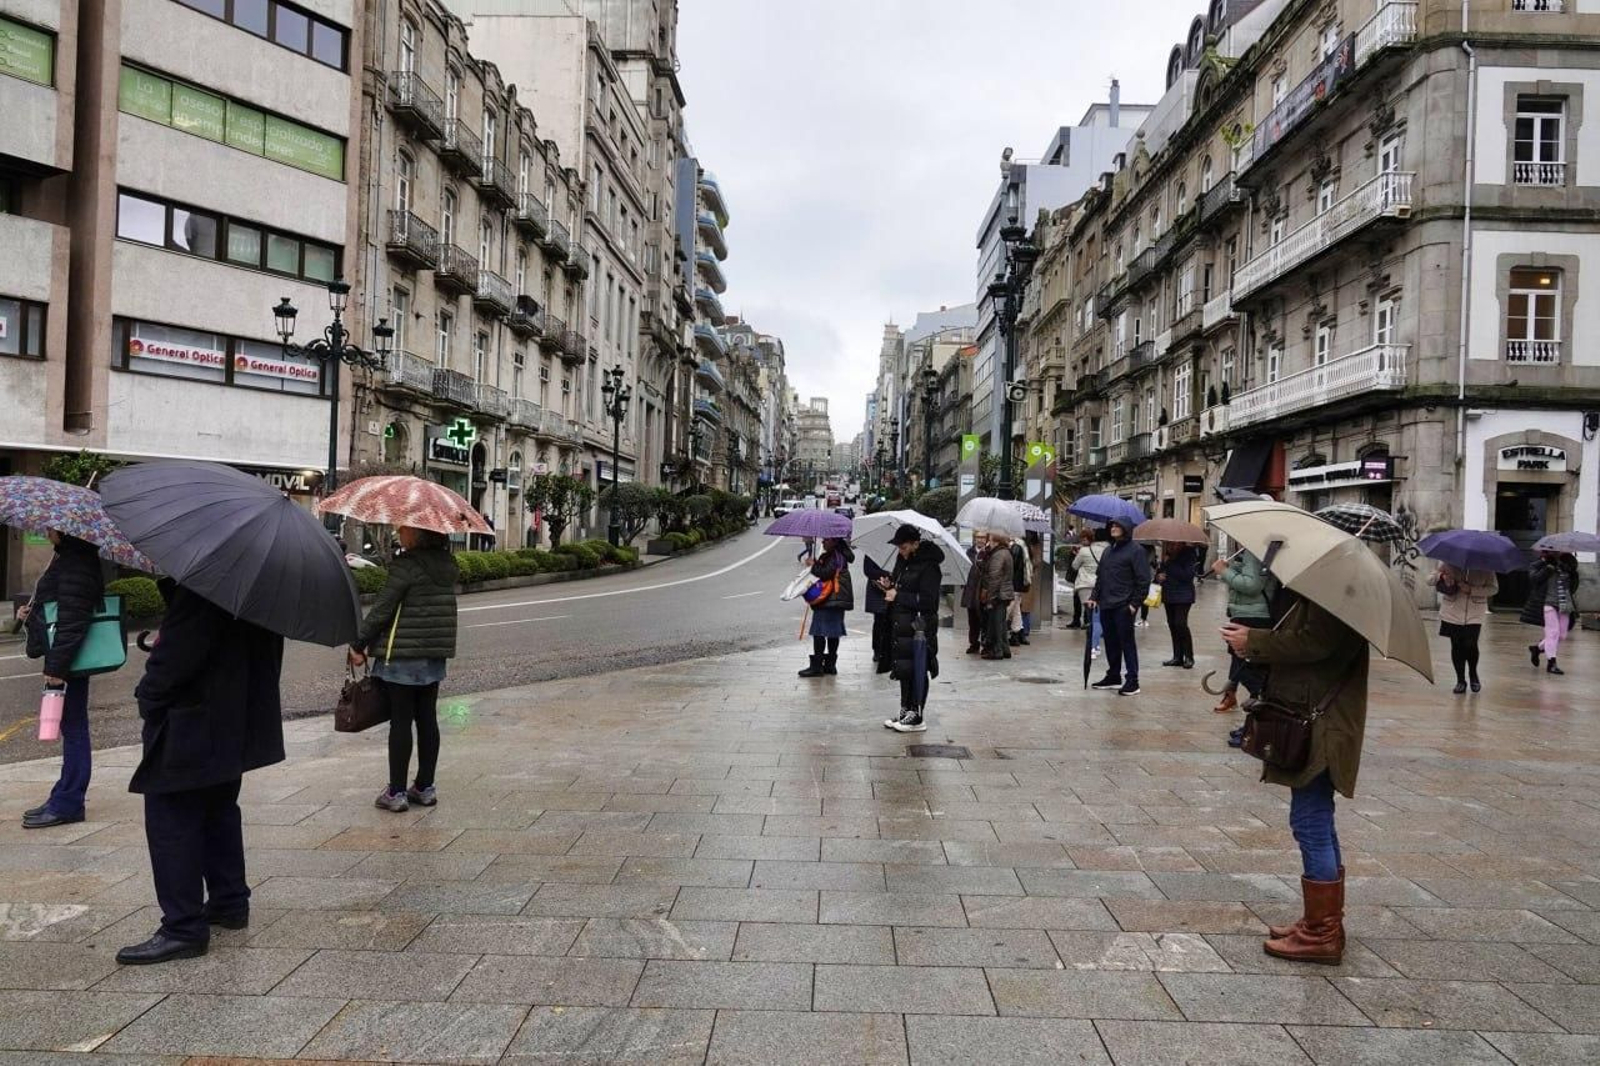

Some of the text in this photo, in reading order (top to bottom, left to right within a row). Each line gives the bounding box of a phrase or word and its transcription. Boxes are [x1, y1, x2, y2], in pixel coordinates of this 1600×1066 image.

[146, 343, 225, 365] General Optica
[250, 360, 318, 379] General Optica
[1501, 446, 1566, 460] ESTRELLA
[1517, 460, 1550, 469] PARK
